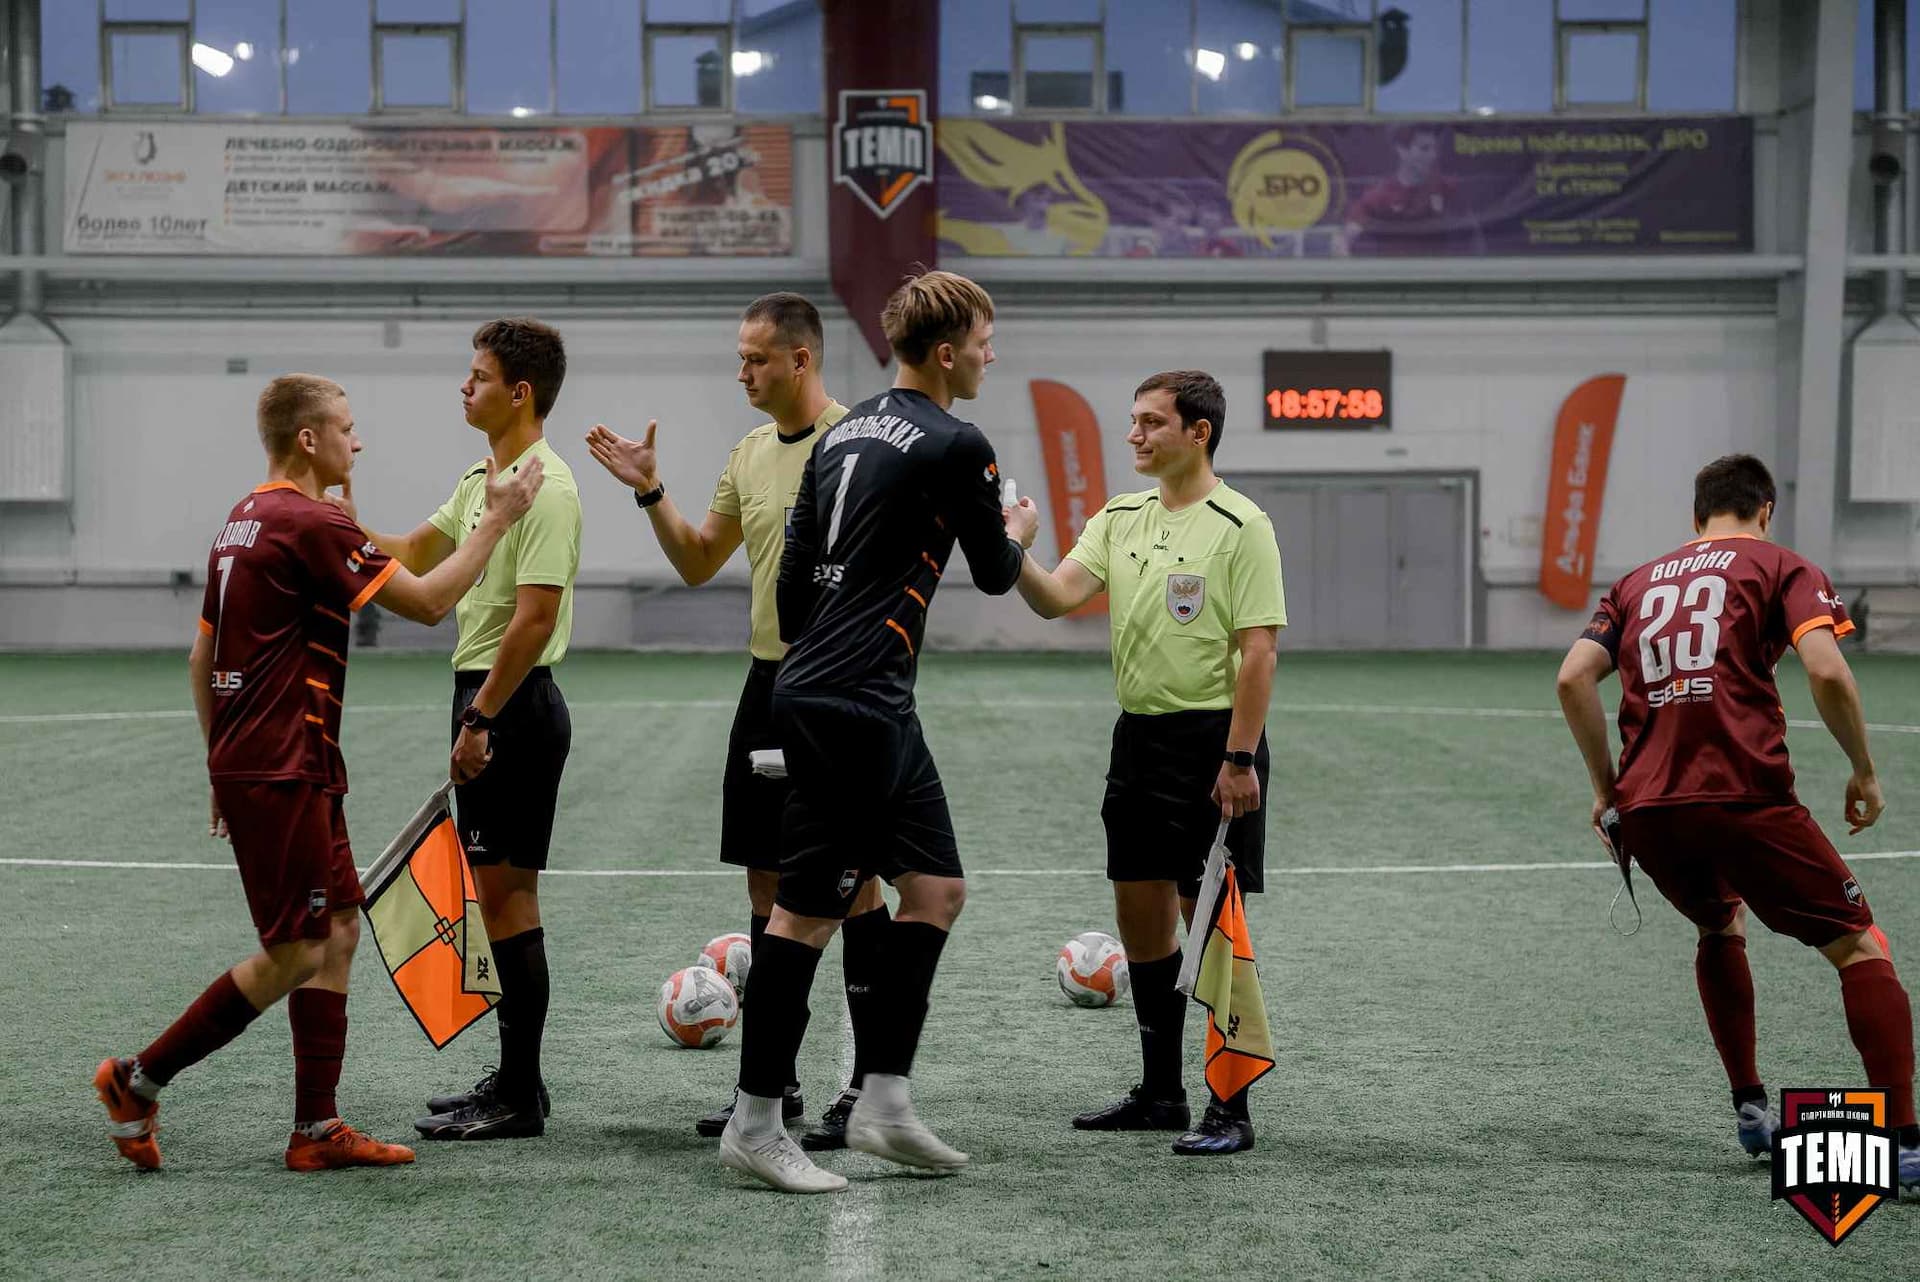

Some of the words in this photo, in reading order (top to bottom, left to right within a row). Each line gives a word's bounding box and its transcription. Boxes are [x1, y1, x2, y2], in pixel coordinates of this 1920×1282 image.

[844, 126, 924, 169] ТЕМП
[827, 453, 860, 555] 1
[1650, 550, 1737, 583] ВОРОНА
[1639, 575, 1728, 684] 23
